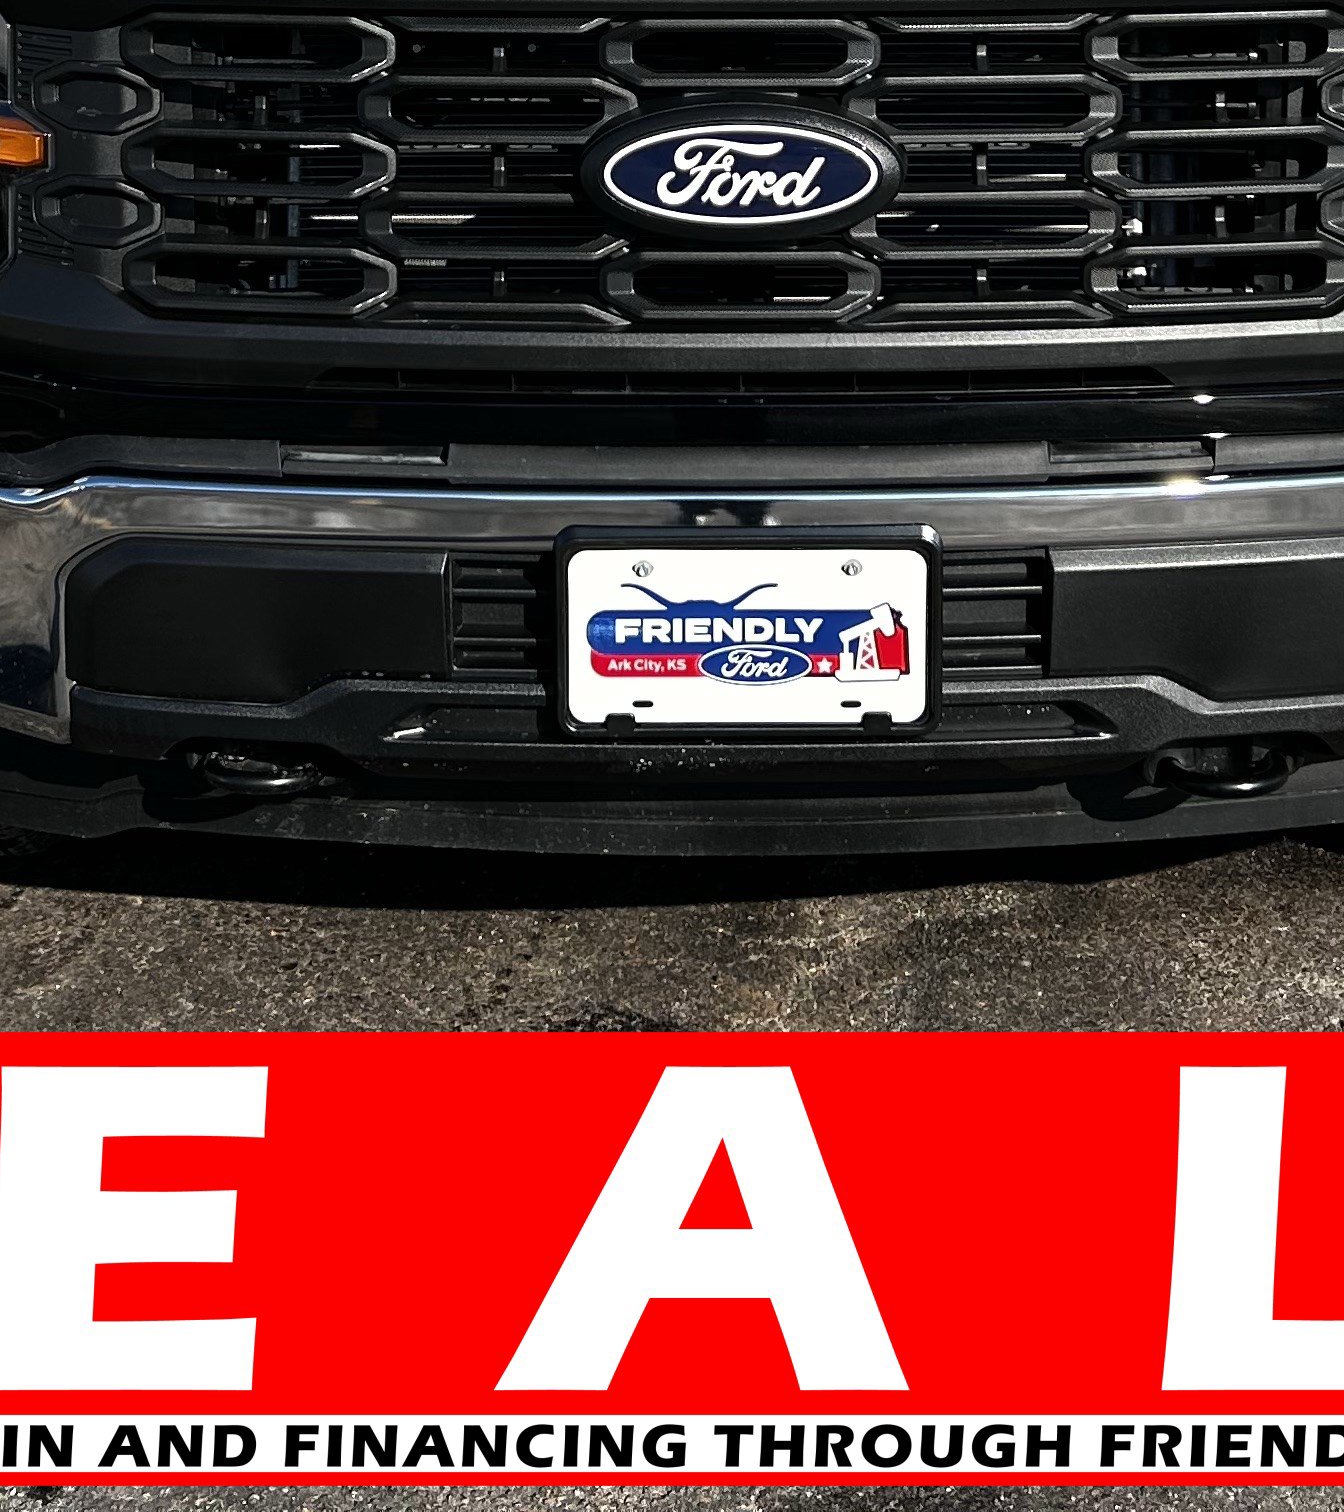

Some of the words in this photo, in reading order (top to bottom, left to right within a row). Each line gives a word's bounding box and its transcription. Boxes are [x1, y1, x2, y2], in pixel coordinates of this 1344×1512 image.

[656, 139, 826, 206] Ford
[615, 618, 823, 643] FRIENDLY
[607, 659, 632, 671] Ark
[634, 659, 665, 673] City,
[667, 659, 687, 671] KS
[721, 649, 789, 677] Ford
